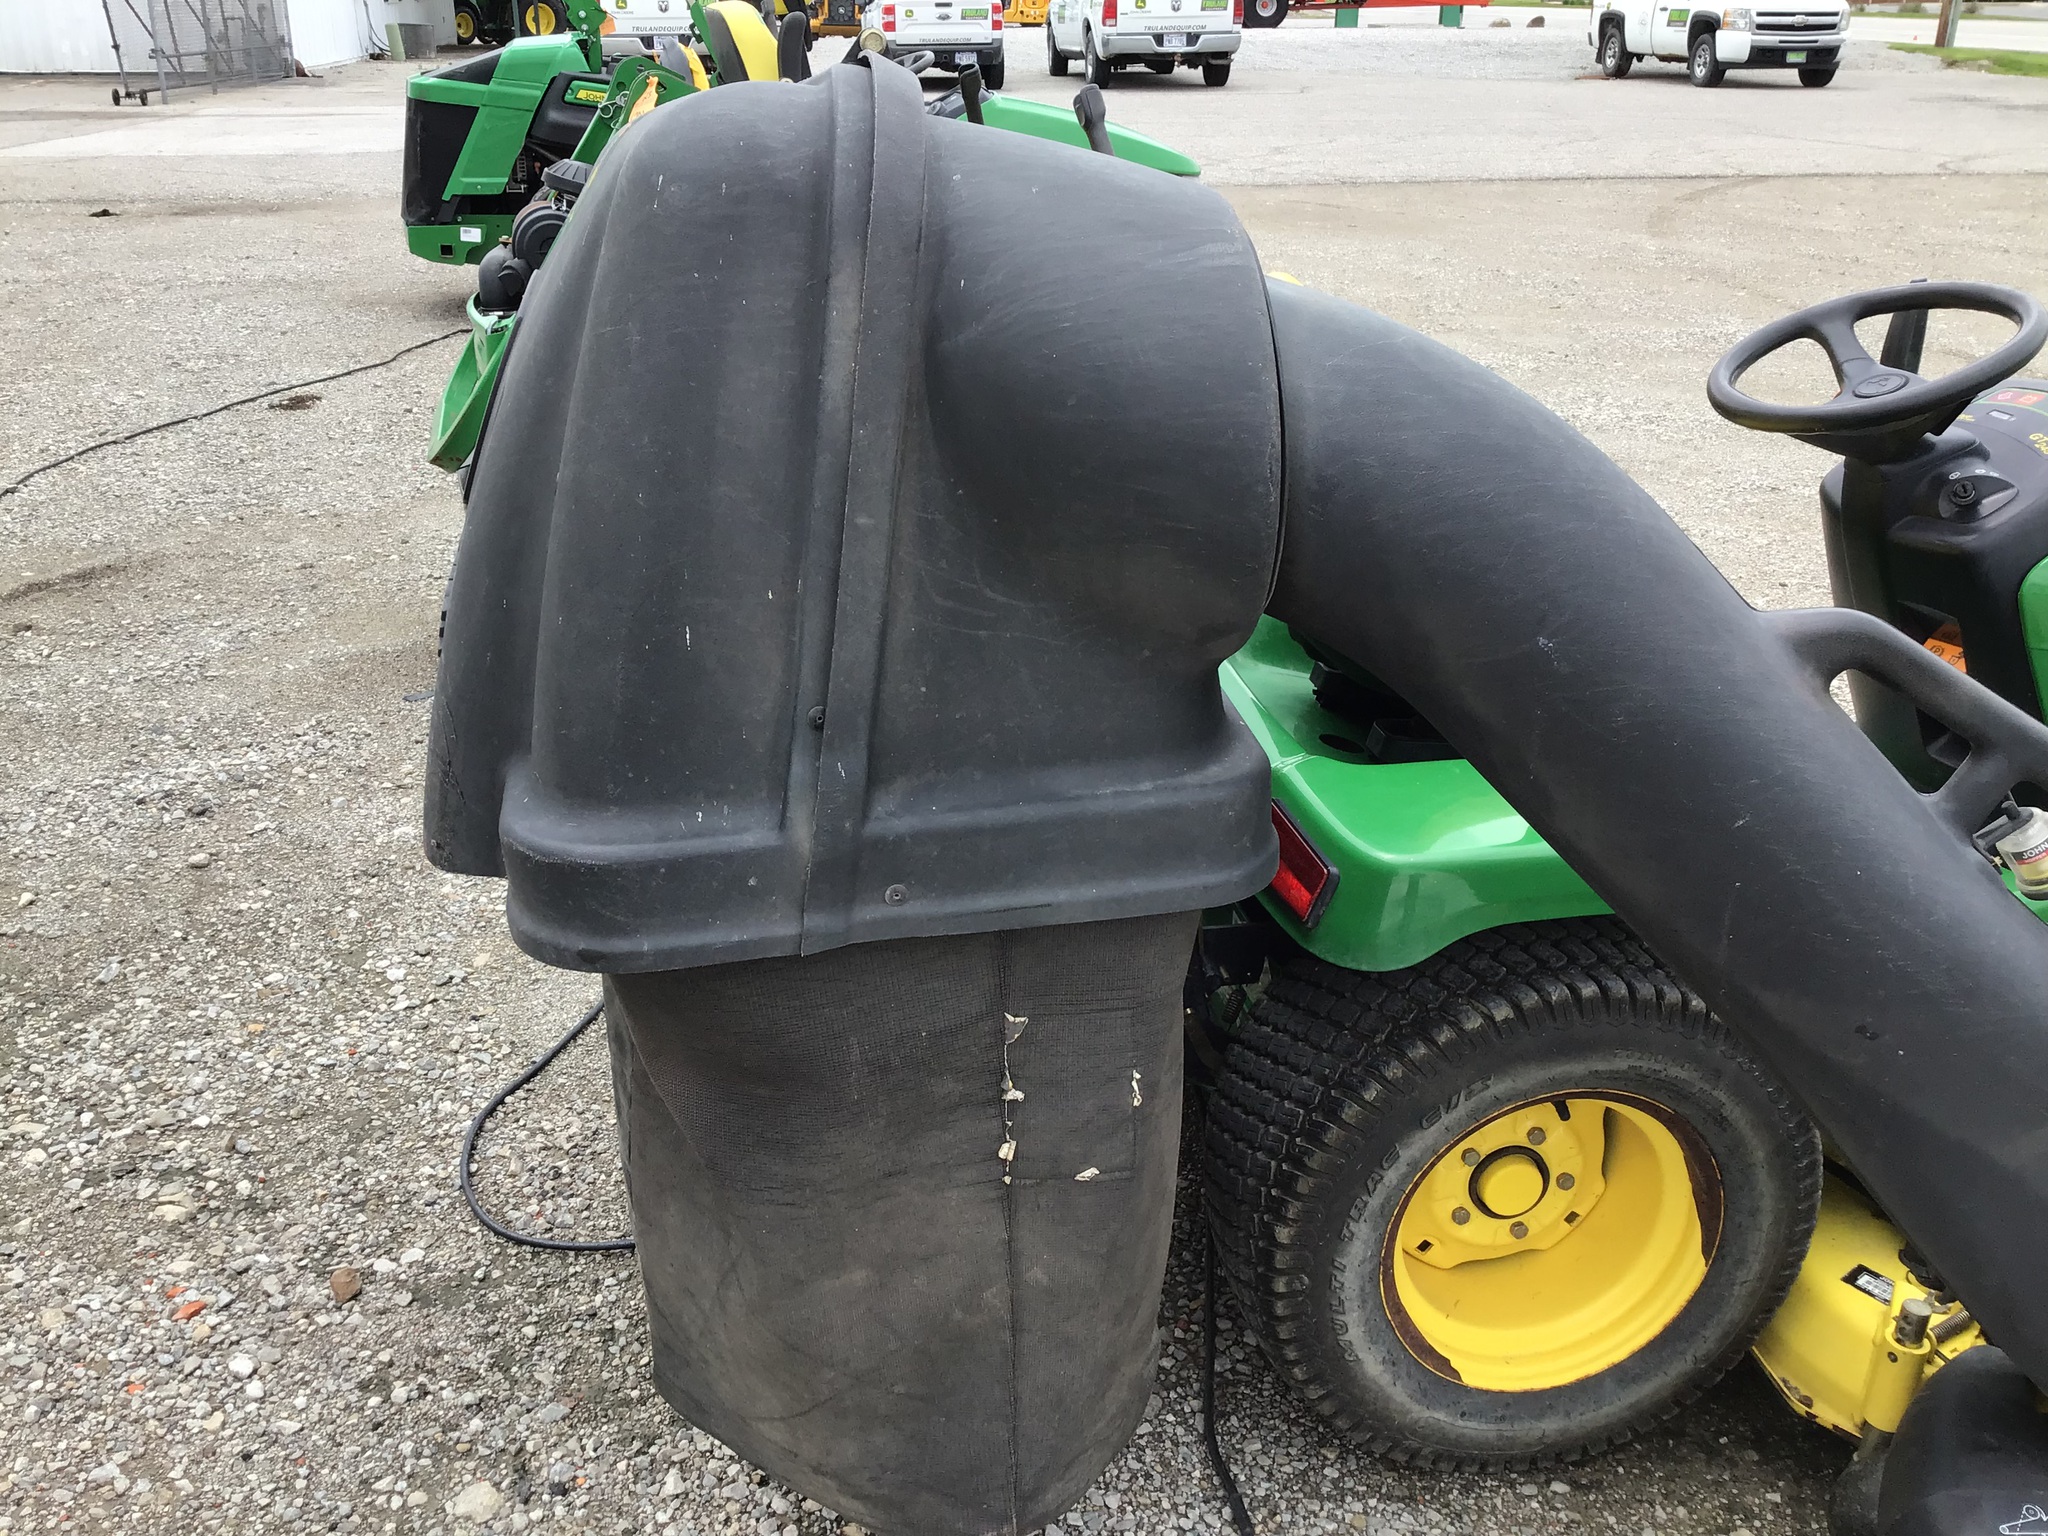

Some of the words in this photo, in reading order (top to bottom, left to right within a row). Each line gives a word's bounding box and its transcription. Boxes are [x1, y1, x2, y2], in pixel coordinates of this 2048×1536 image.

[2022, 842, 2048, 859] JOHN
[1340, 1143, 1401, 1243] TRAC
[1329, 1258, 1360, 1363] MULTI
